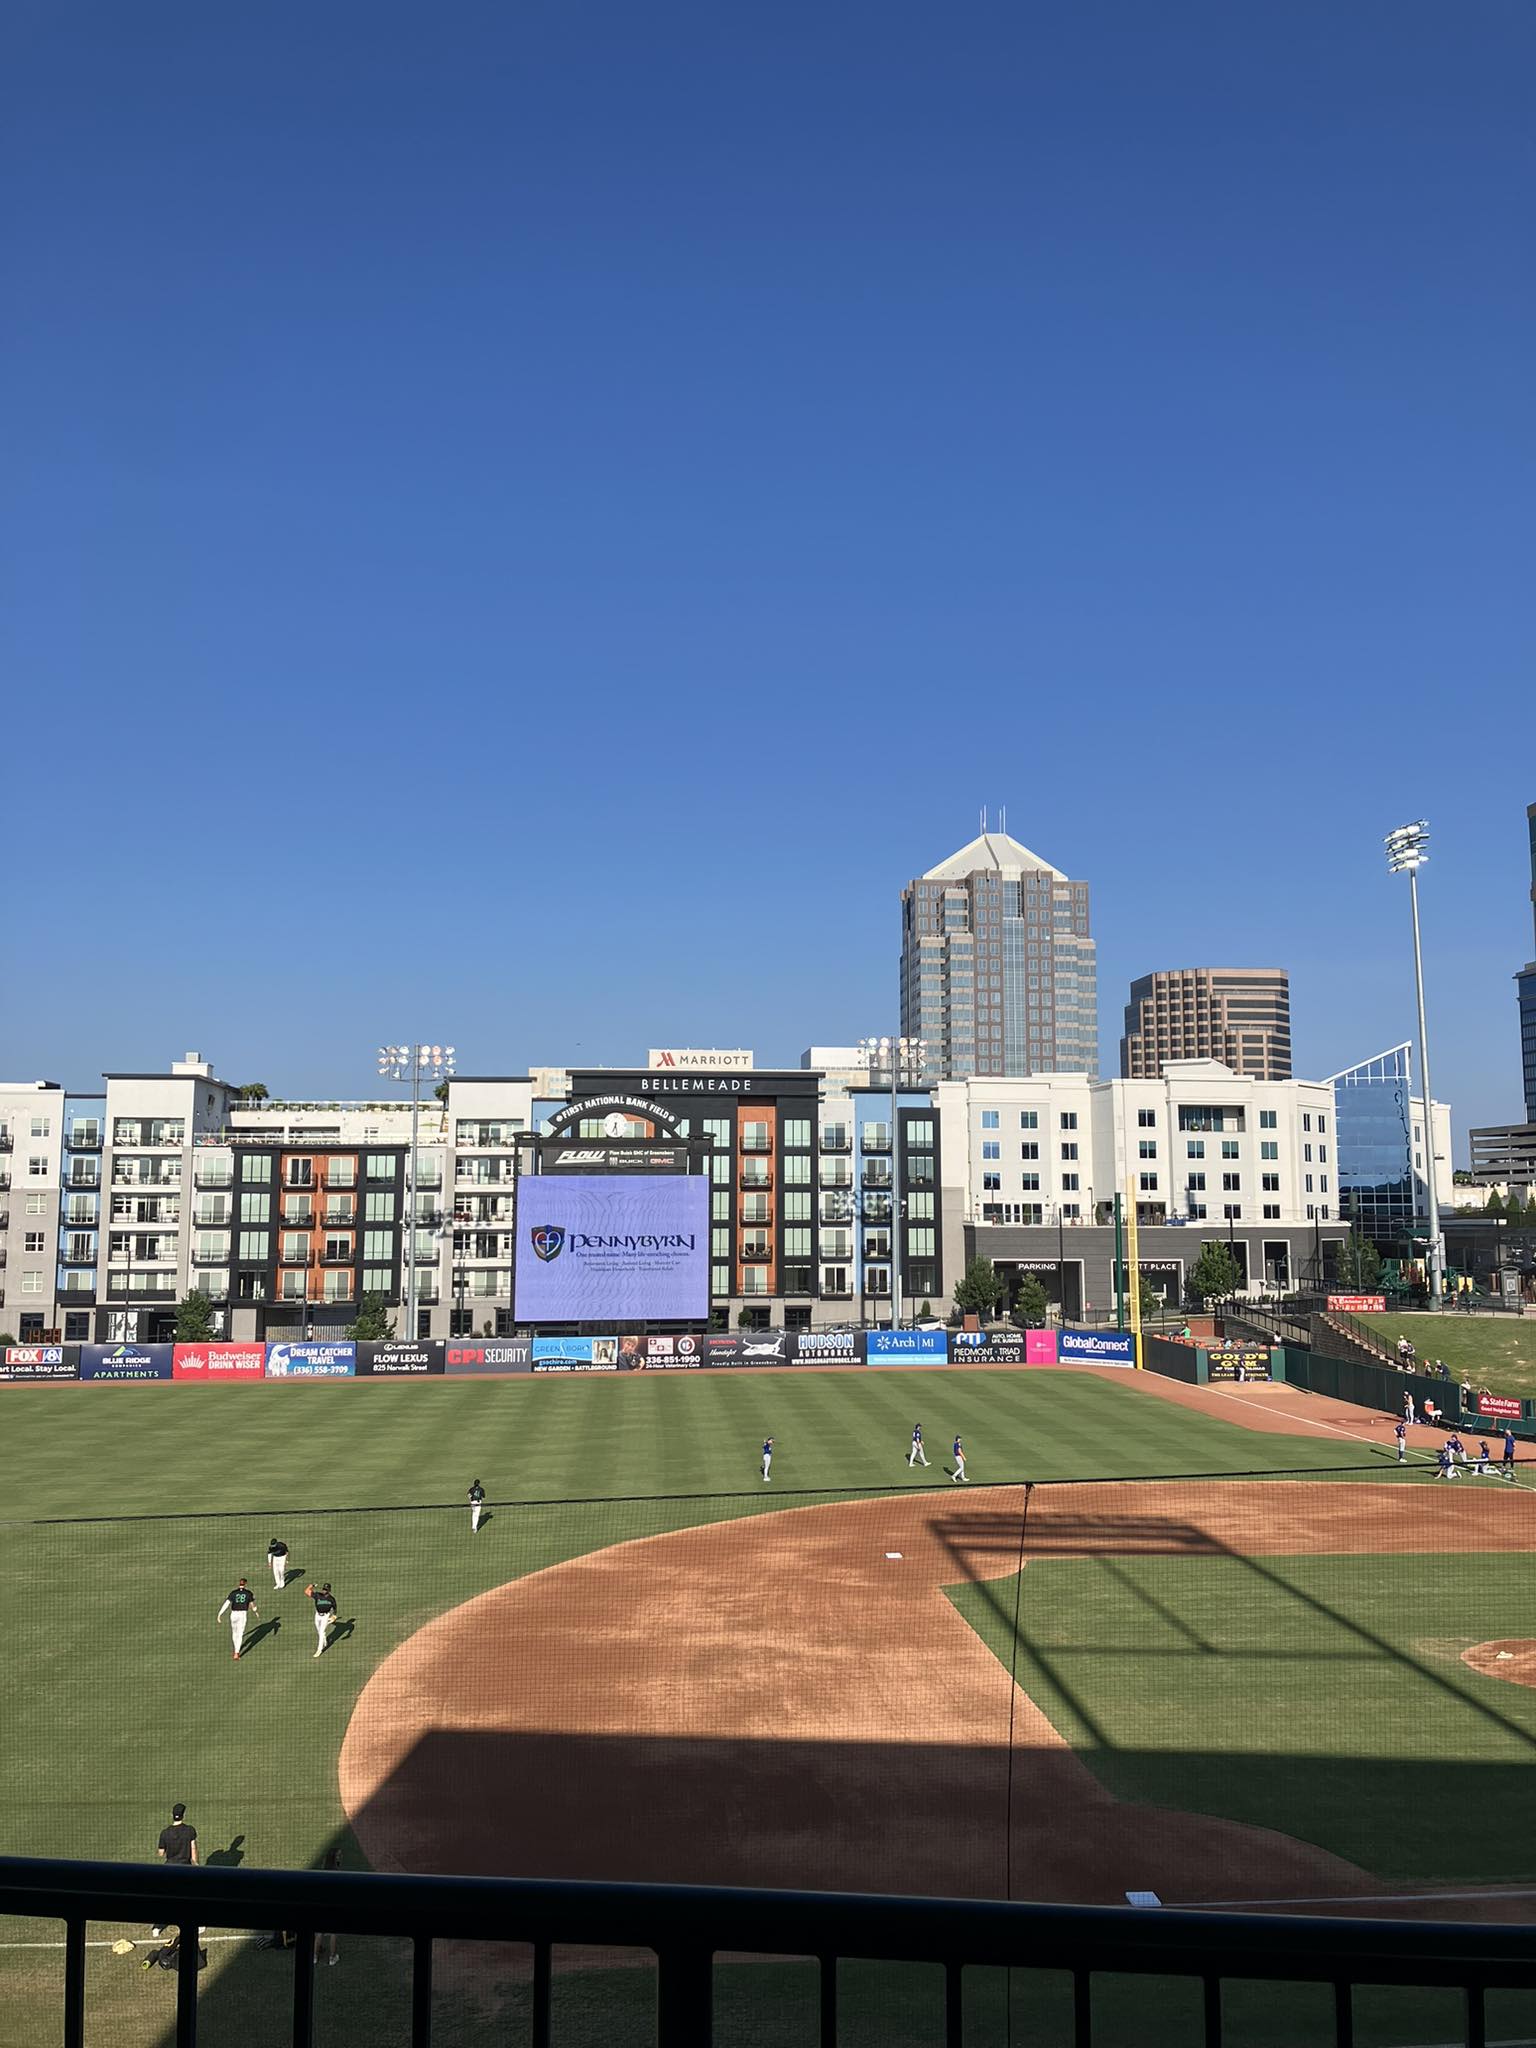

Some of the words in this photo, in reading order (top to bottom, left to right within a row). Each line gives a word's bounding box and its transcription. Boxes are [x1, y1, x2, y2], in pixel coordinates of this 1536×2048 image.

[680, 1056, 749, 1065] MARRIOTT
[641, 1078, 751, 1091] BELLEMEADE
[562, 1103, 584, 1119] FIRST
[585, 1095, 625, 1110] NATIONAL
[626, 1097, 649, 1110] BANK
[649, 1104, 670, 1121] FIELD
[558, 1150, 606, 1160] FLOW
[568, 1233, 696, 1252] PENNYBYRN
[798, 1334, 854, 1349] HUDSON
[892, 1336, 915, 1347] Arch
[922, 1338, 934, 1347] MI
[956, 1332, 980, 1344] PTI
[1063, 1335, 1129, 1352] GlobalConnect
[10, 1350, 39, 1362] FOX
[47, 1350, 57, 1362] 8
[208, 1351, 262, 1360] Budweiser
[290, 1348, 318, 1357] DREAM
[319, 1347, 353, 1356] CATCHER
[448, 1349, 485, 1365] CPI
[485, 1348, 527, 1363] SECURITY
[799, 1349, 854, 1357] AUTOWORKS
[954, 1348, 993, 1356] PIEDMONT
[1000, 1347, 1020, 1355] TRIAD
[373, 1354, 398, 1363] FLOW
[400, 1354, 428, 1362] LEXUS
[646, 1355, 701, 1364] 336-851-1990
[35, 1365, 52, 1373] Stay
[54, 1364, 77, 1372] Local.
[208, 1360, 233, 1370] DRINK
[235, 1360, 261, 1369] WISER
[293, 1366, 313, 1375] (336)
[314, 1365, 348, 1375] 558-3709
[94, 1370, 159, 1379] APARTMENTS
[235, 1594, 246, 1603] 28
